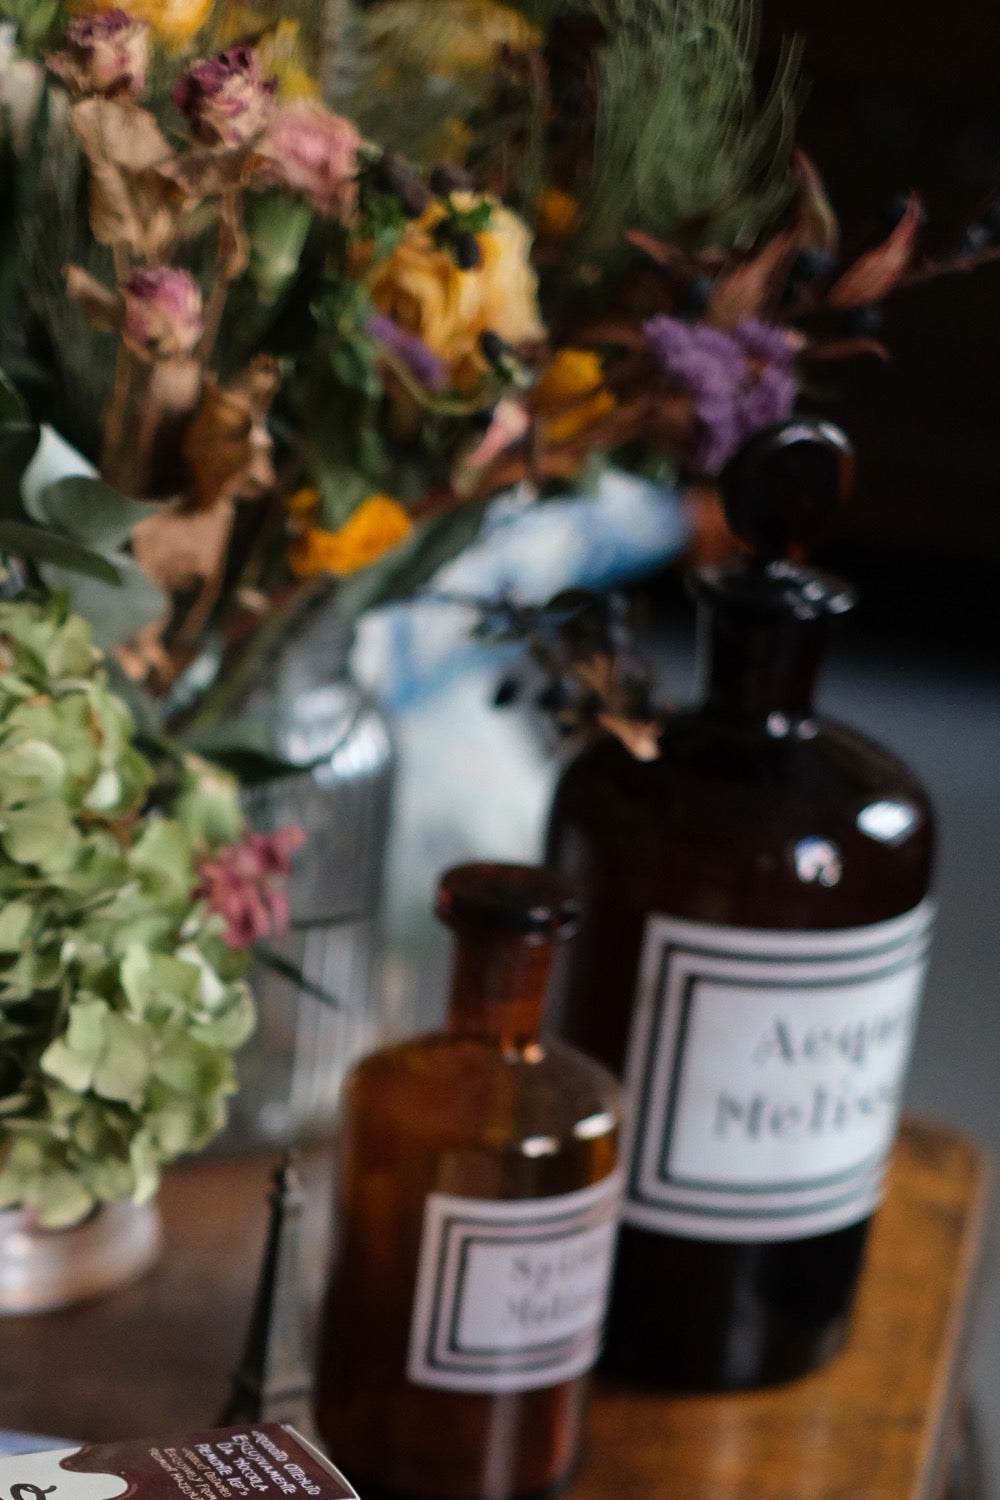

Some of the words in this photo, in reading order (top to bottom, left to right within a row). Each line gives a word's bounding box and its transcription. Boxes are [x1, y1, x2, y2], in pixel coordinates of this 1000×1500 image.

[195, 1443, 233, 1476] PIEMONTE
[216, 1442, 234, 1456] DA
[232, 1434, 297, 1495] ESCLUSIVAMENTE
[283, 1463, 321, 1495] OTTENUTO
